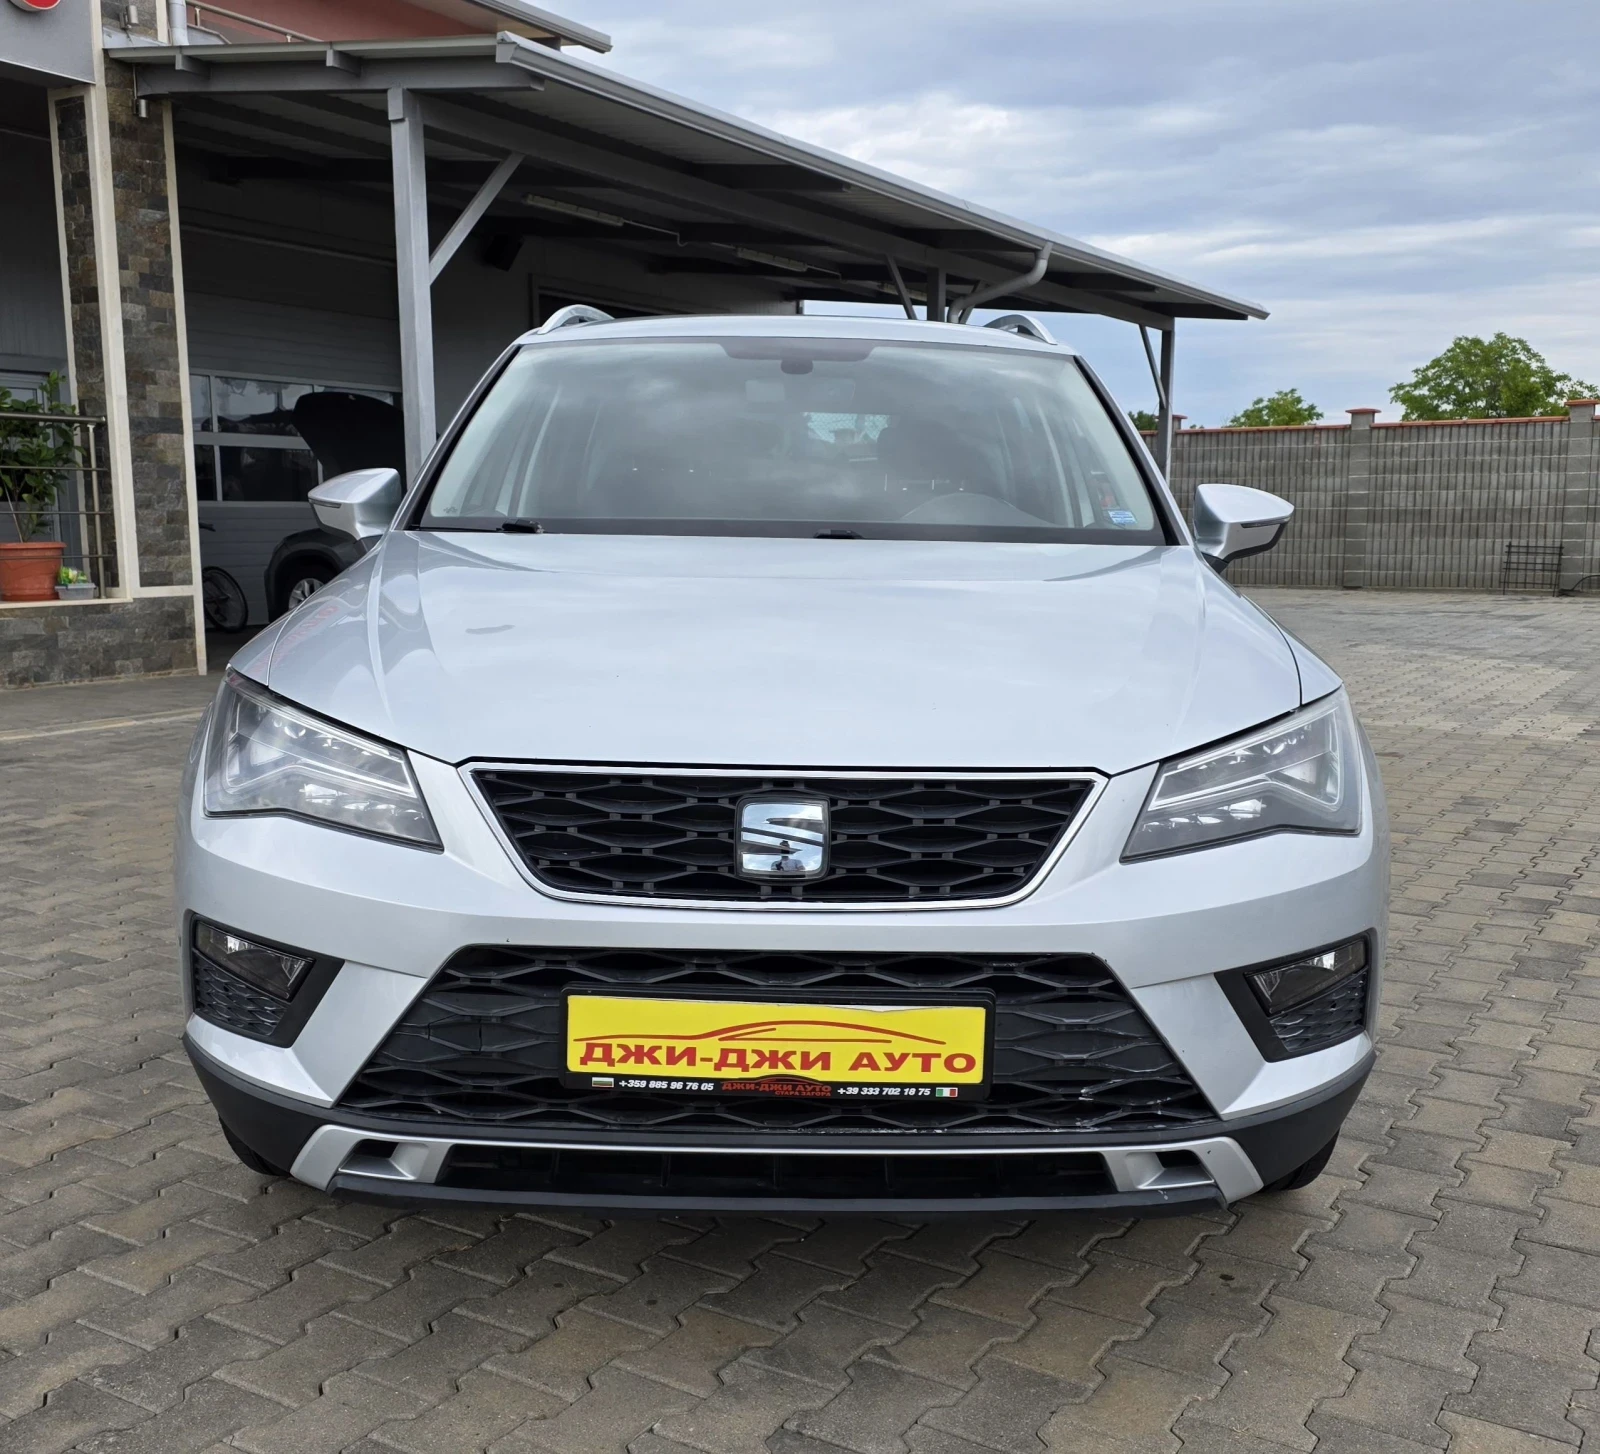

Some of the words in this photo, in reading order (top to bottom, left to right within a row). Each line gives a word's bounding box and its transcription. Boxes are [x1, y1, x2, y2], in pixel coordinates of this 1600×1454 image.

[579, 1042, 831, 1073] ДЖИ-ДЖИ
[848, 1051, 977, 1074] АУТО
[619, 1079, 647, 1088] +359
[648, 1080, 668, 1089] 885
[670, 1081, 683, 1090] 96
[686, 1082, 699, 1090] 76
[701, 1082, 714, 1091] 05
[721, 1082, 793, 1092] ДЖИ-ДЖИ
[795, 1084, 832, 1092] АУТО
[837, 1087, 858, 1095] +39
[861, 1087, 880, 1095] 333
[882, 1087, 900, 1096] 702
[903, 1087, 915, 1096] 18
[918, 1088, 931, 1096] 75
